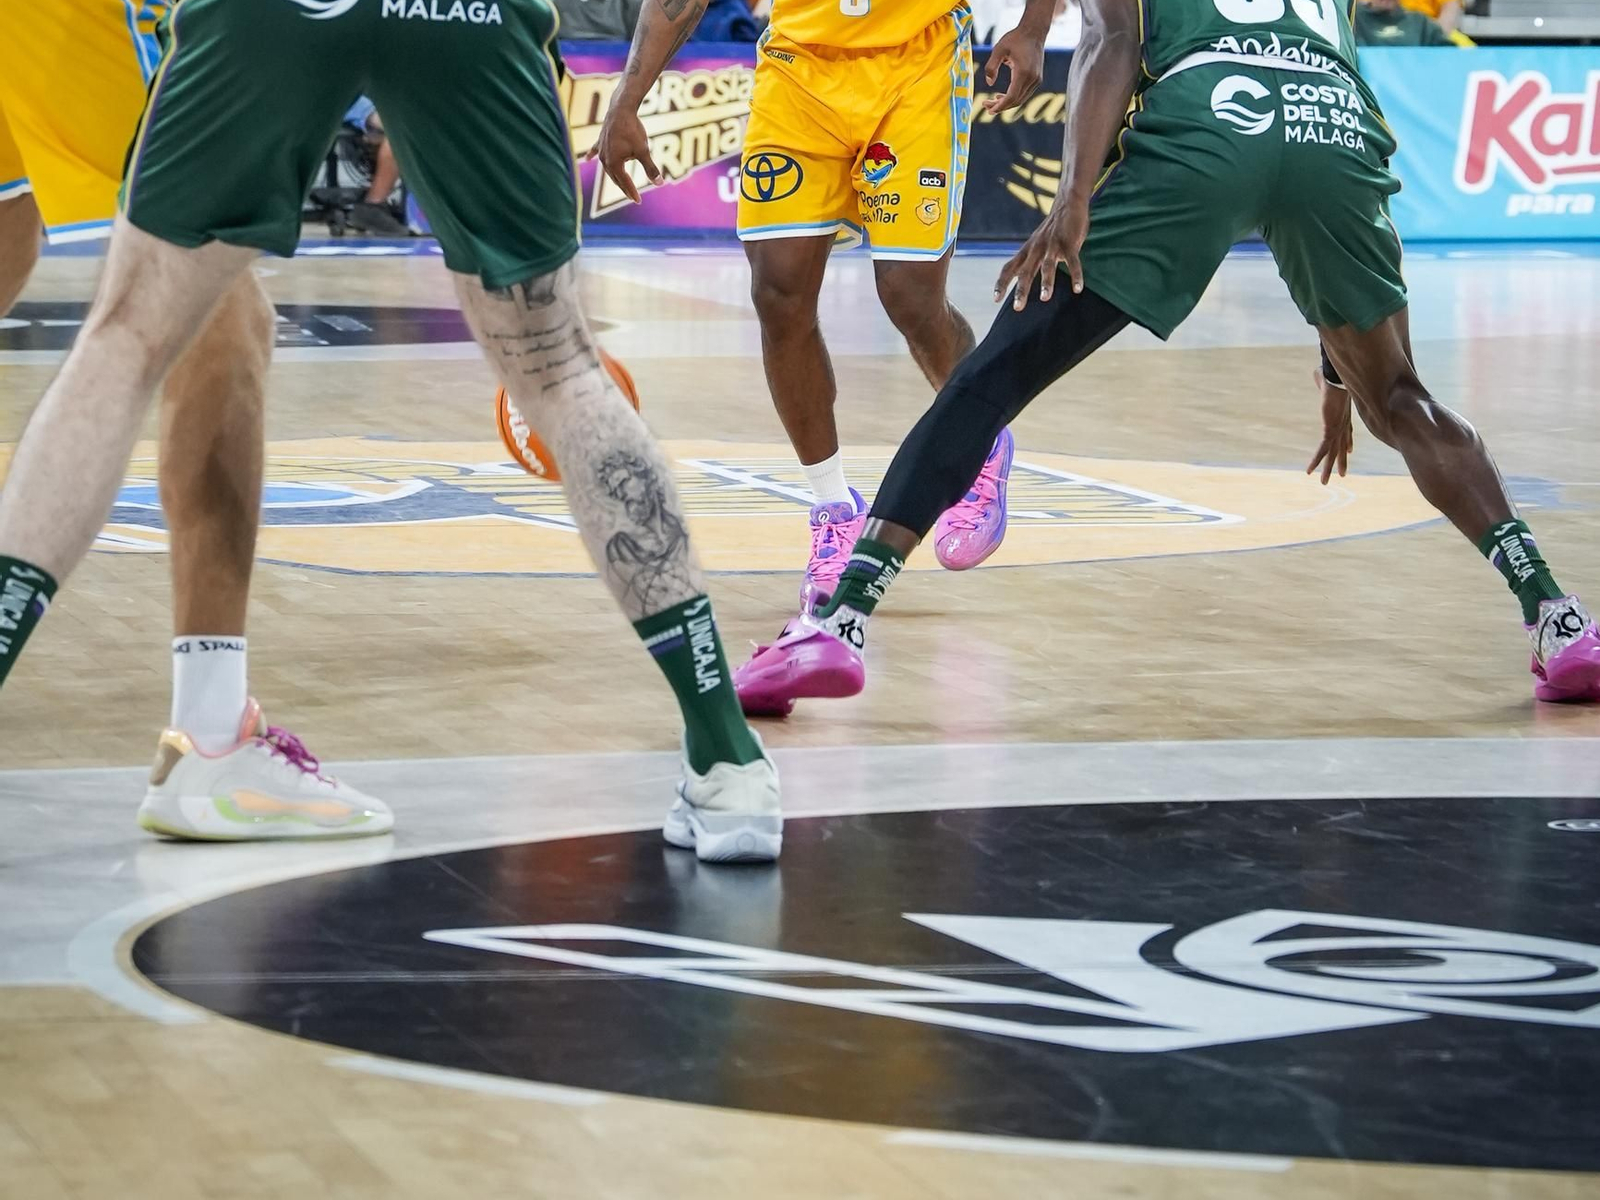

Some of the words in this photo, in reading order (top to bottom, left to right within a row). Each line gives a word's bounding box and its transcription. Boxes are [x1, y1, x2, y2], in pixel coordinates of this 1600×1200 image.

[1280, 82, 1364, 115] COSTA
[1283, 103, 1328, 124] DEL
[1329, 107, 1368, 134] SOL
[1284, 120, 1366, 153] MÁLAGA
[921, 176, 942, 186] acb
[859, 190, 901, 209] Poema
[1504, 193, 1596, 218] para
[686, 612, 722, 694] UNICAJA
